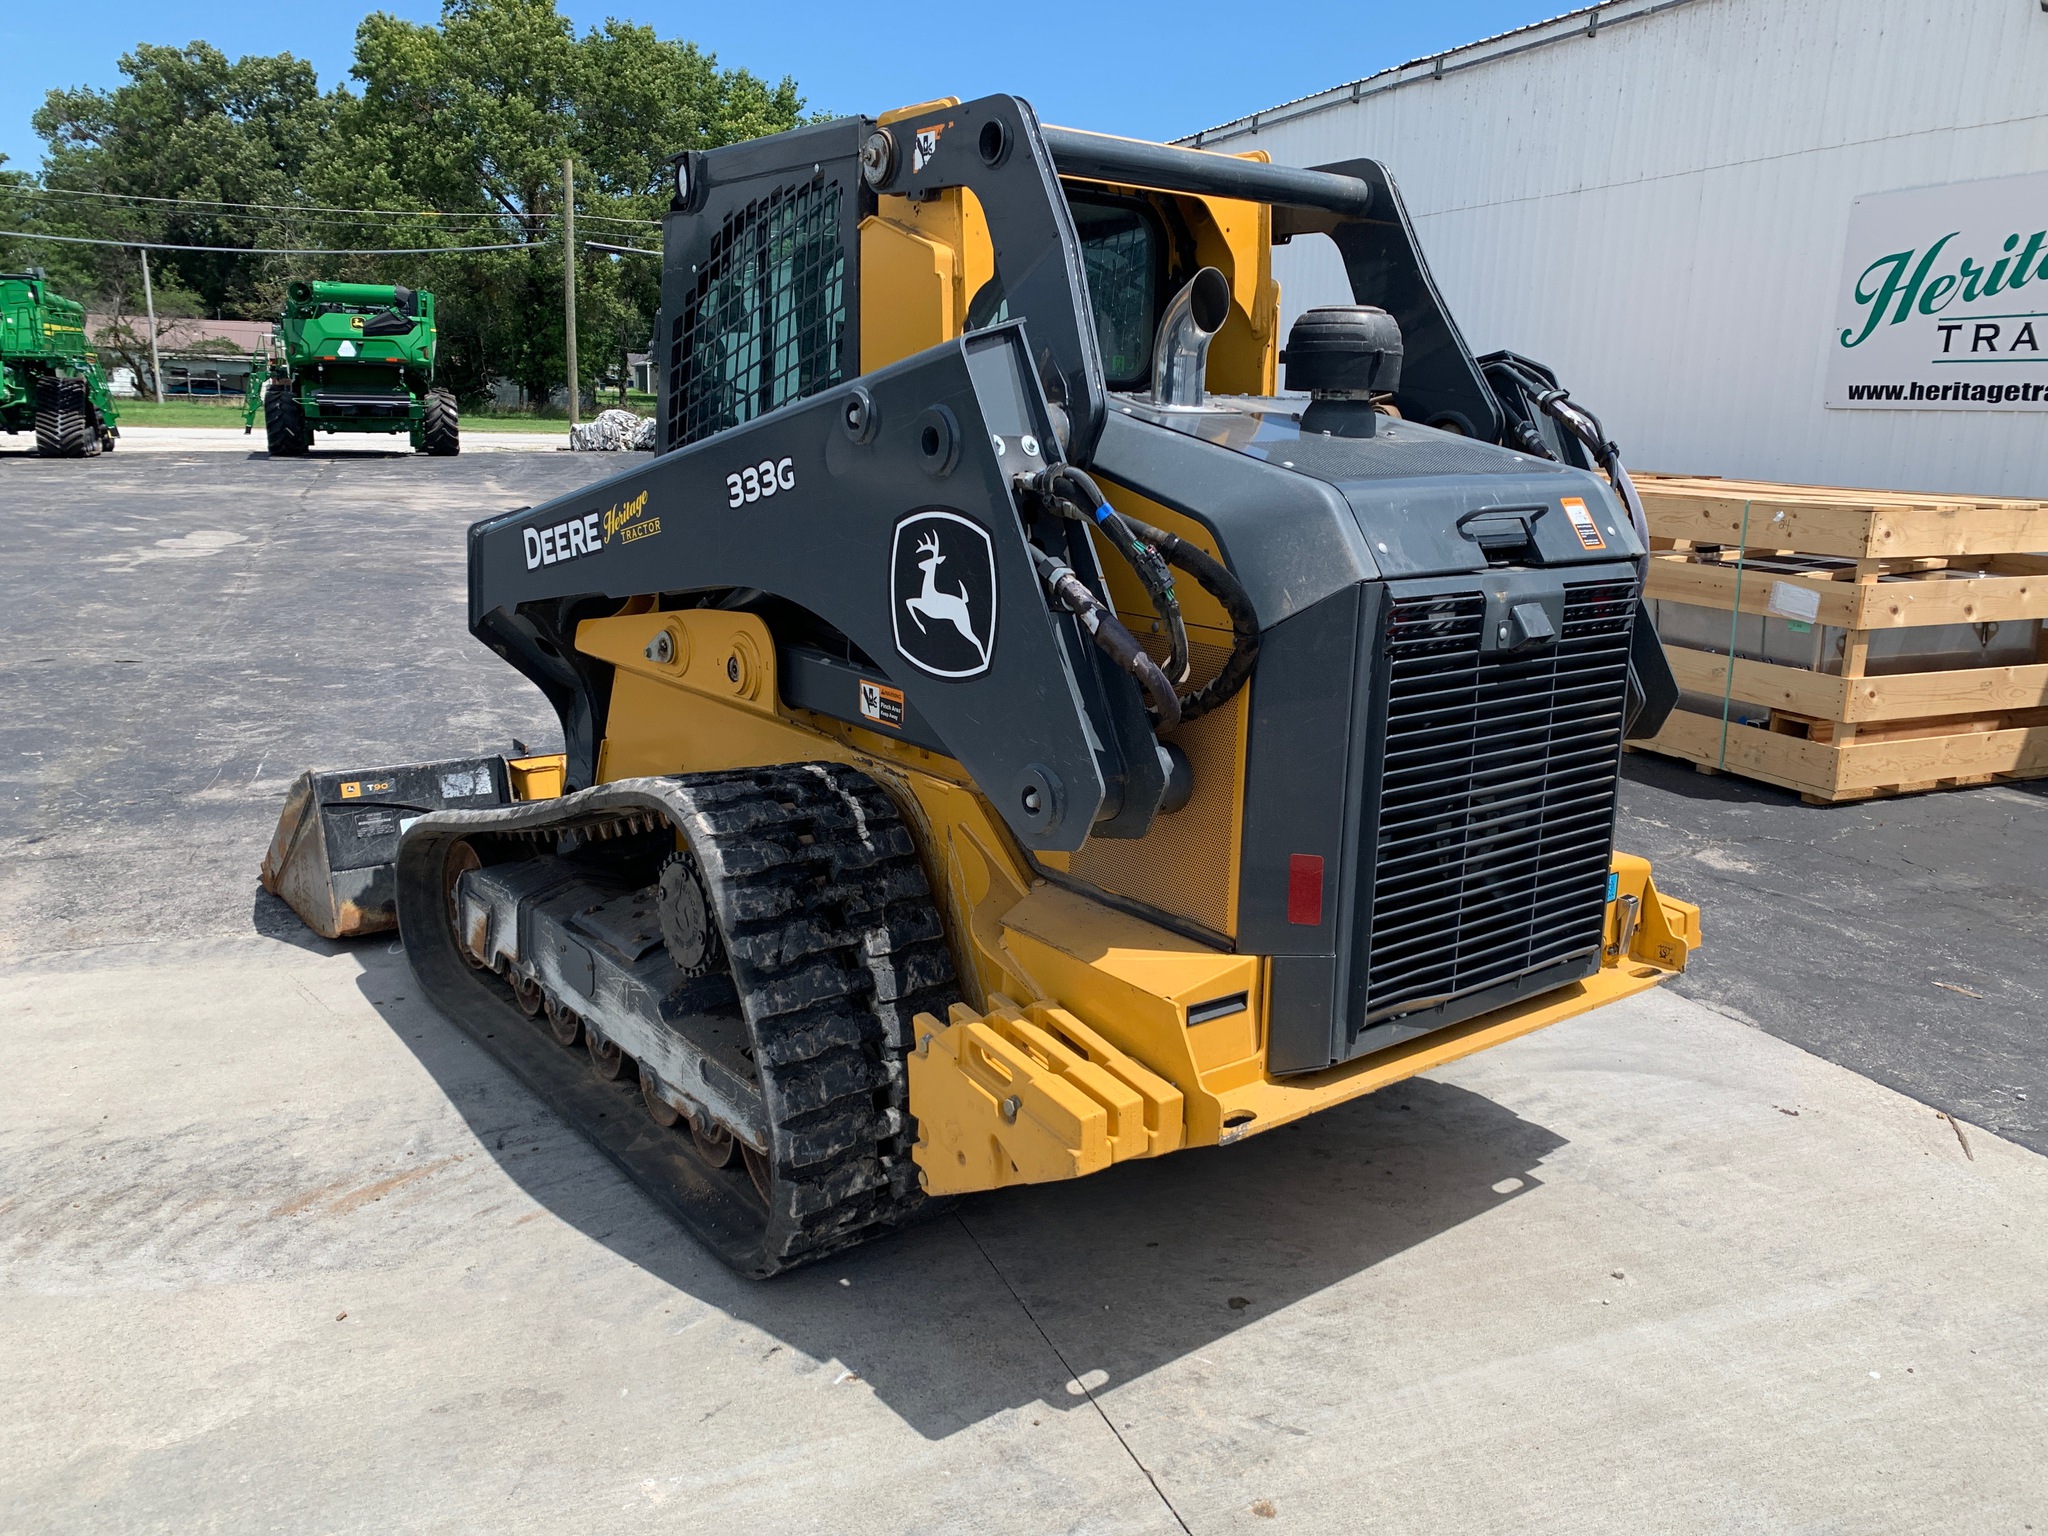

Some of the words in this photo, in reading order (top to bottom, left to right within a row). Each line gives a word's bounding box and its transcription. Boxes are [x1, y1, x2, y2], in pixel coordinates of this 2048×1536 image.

[1937, 321, 2040, 352] TRA
[725, 457, 797, 509] 333G
[603, 489, 649, 544] Heritage
[620, 520, 661, 541] TRACTOR
[522, 511, 603, 571] DEERE
[367, 783, 388, 791] T90
